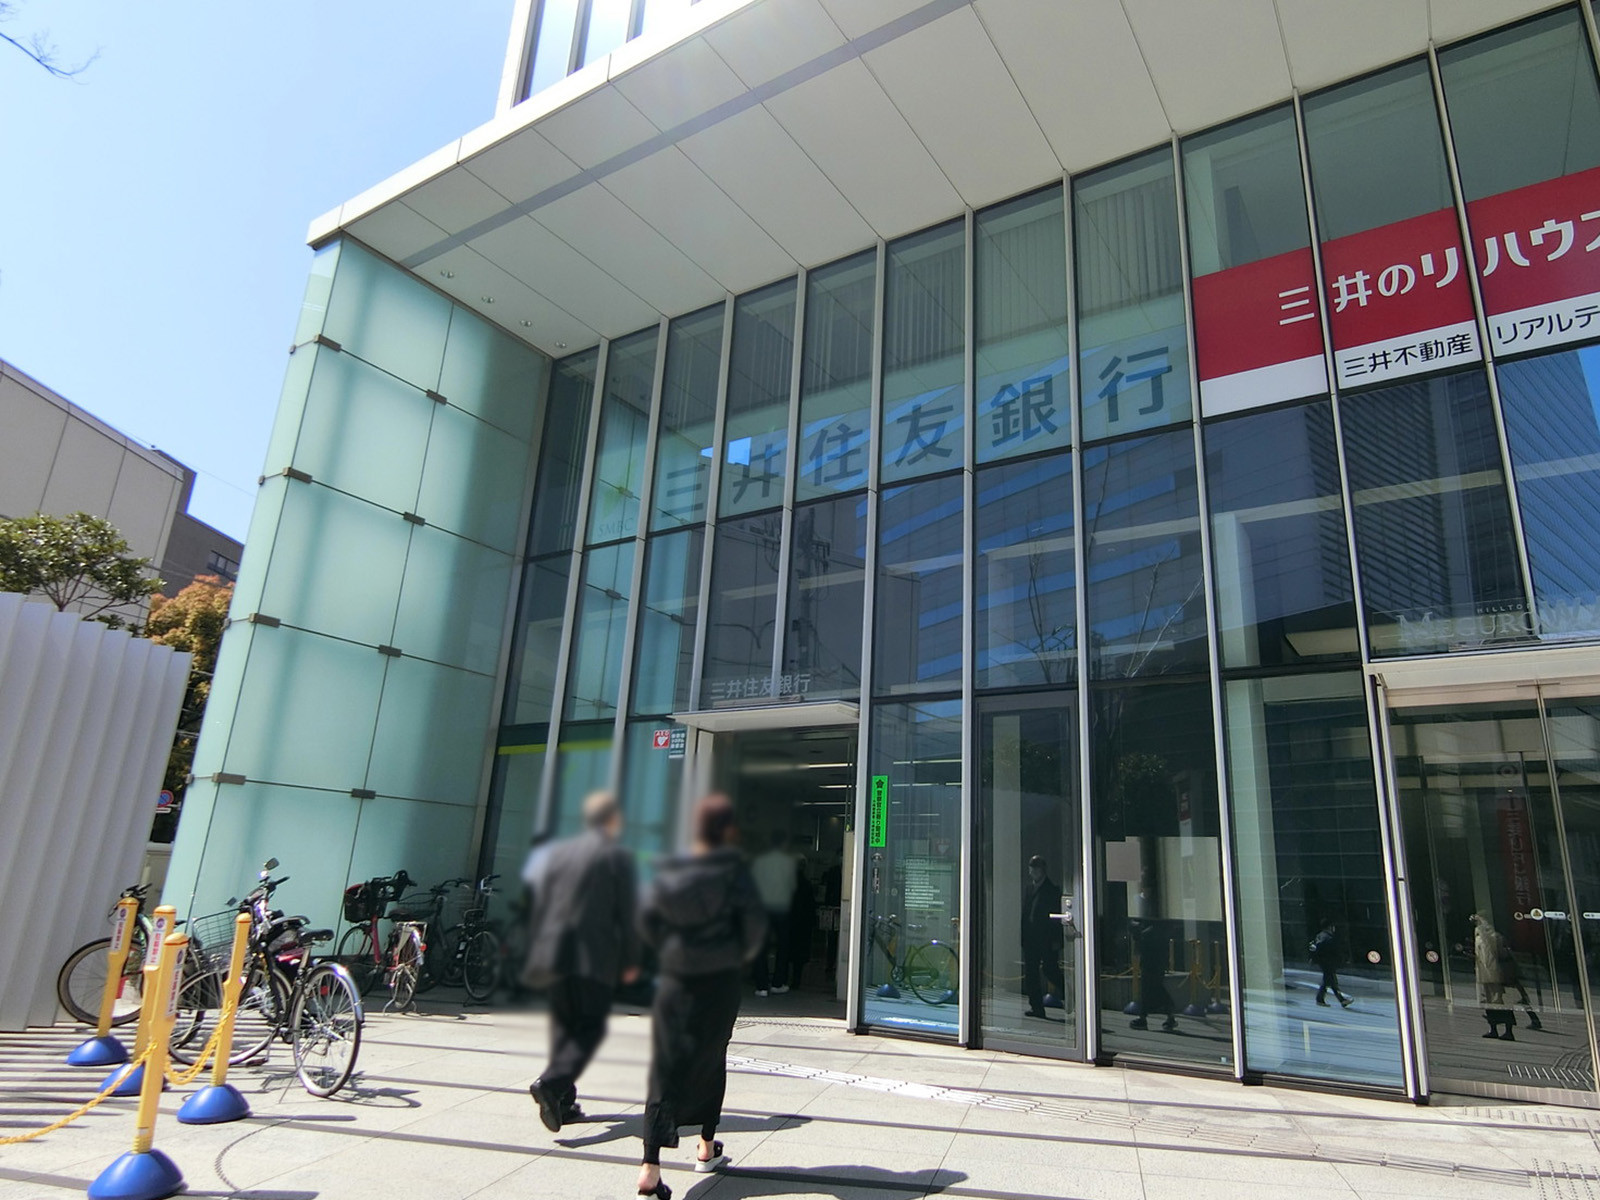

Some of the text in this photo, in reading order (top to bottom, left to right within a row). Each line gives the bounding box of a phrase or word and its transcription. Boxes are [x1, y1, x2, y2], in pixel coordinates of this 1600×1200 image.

[661, 346, 1173, 518] 三井住友銀行
[710, 674, 811, 699] 三井住友銀行
